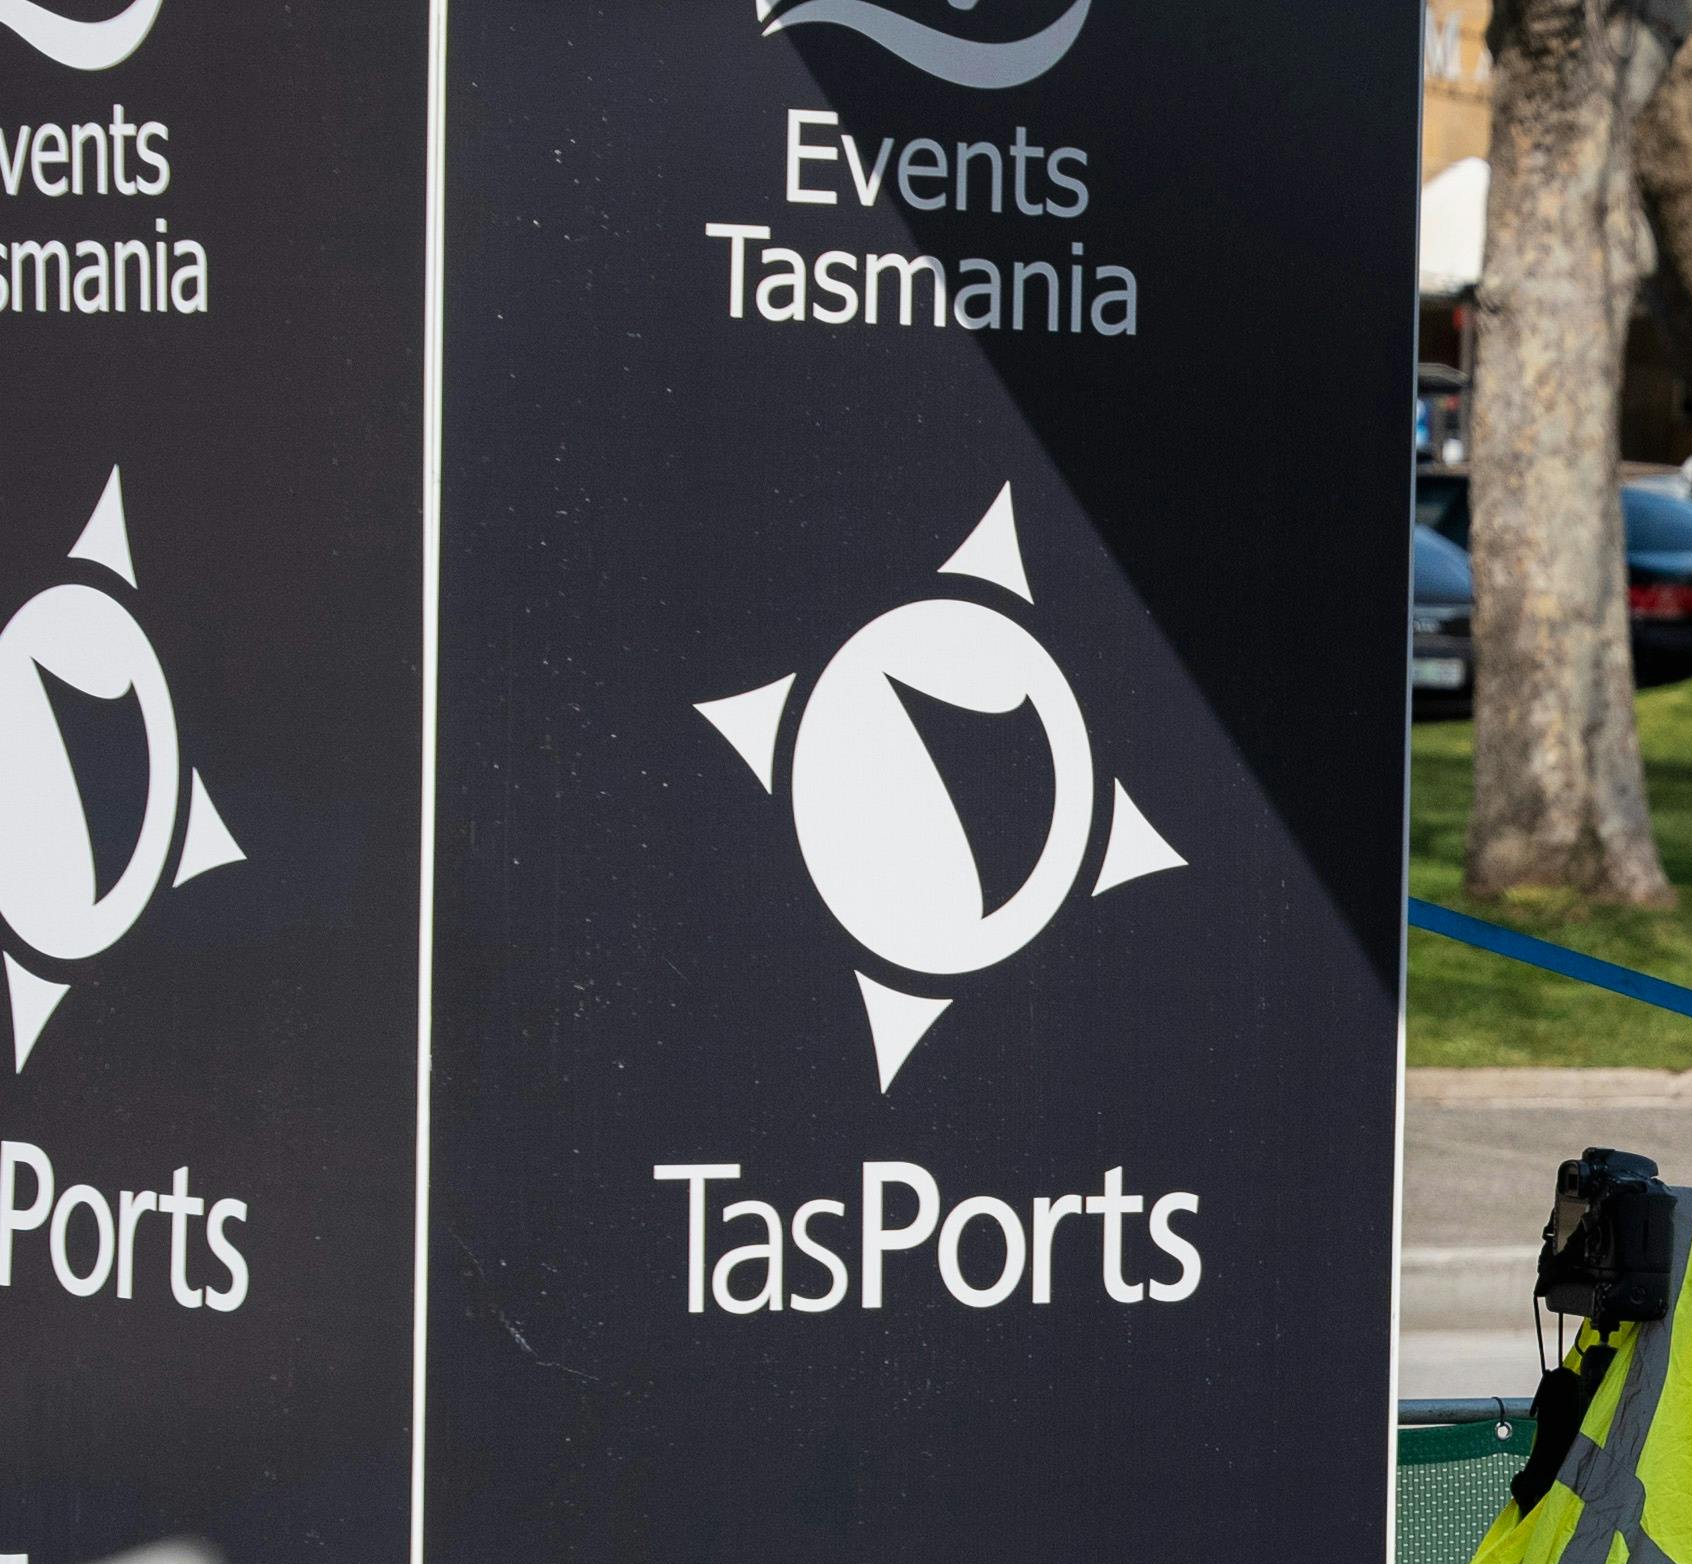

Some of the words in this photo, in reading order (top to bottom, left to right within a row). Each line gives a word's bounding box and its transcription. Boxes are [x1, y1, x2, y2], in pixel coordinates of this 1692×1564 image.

[0, 104, 170, 196] vents
[786, 108, 1089, 218] Events
[0, 218, 208, 313] smania
[705, 222, 1138, 335] Tasmania
[0, 1141, 249, 1312] Ports
[653, 1161, 1201, 1314] TasPorts
